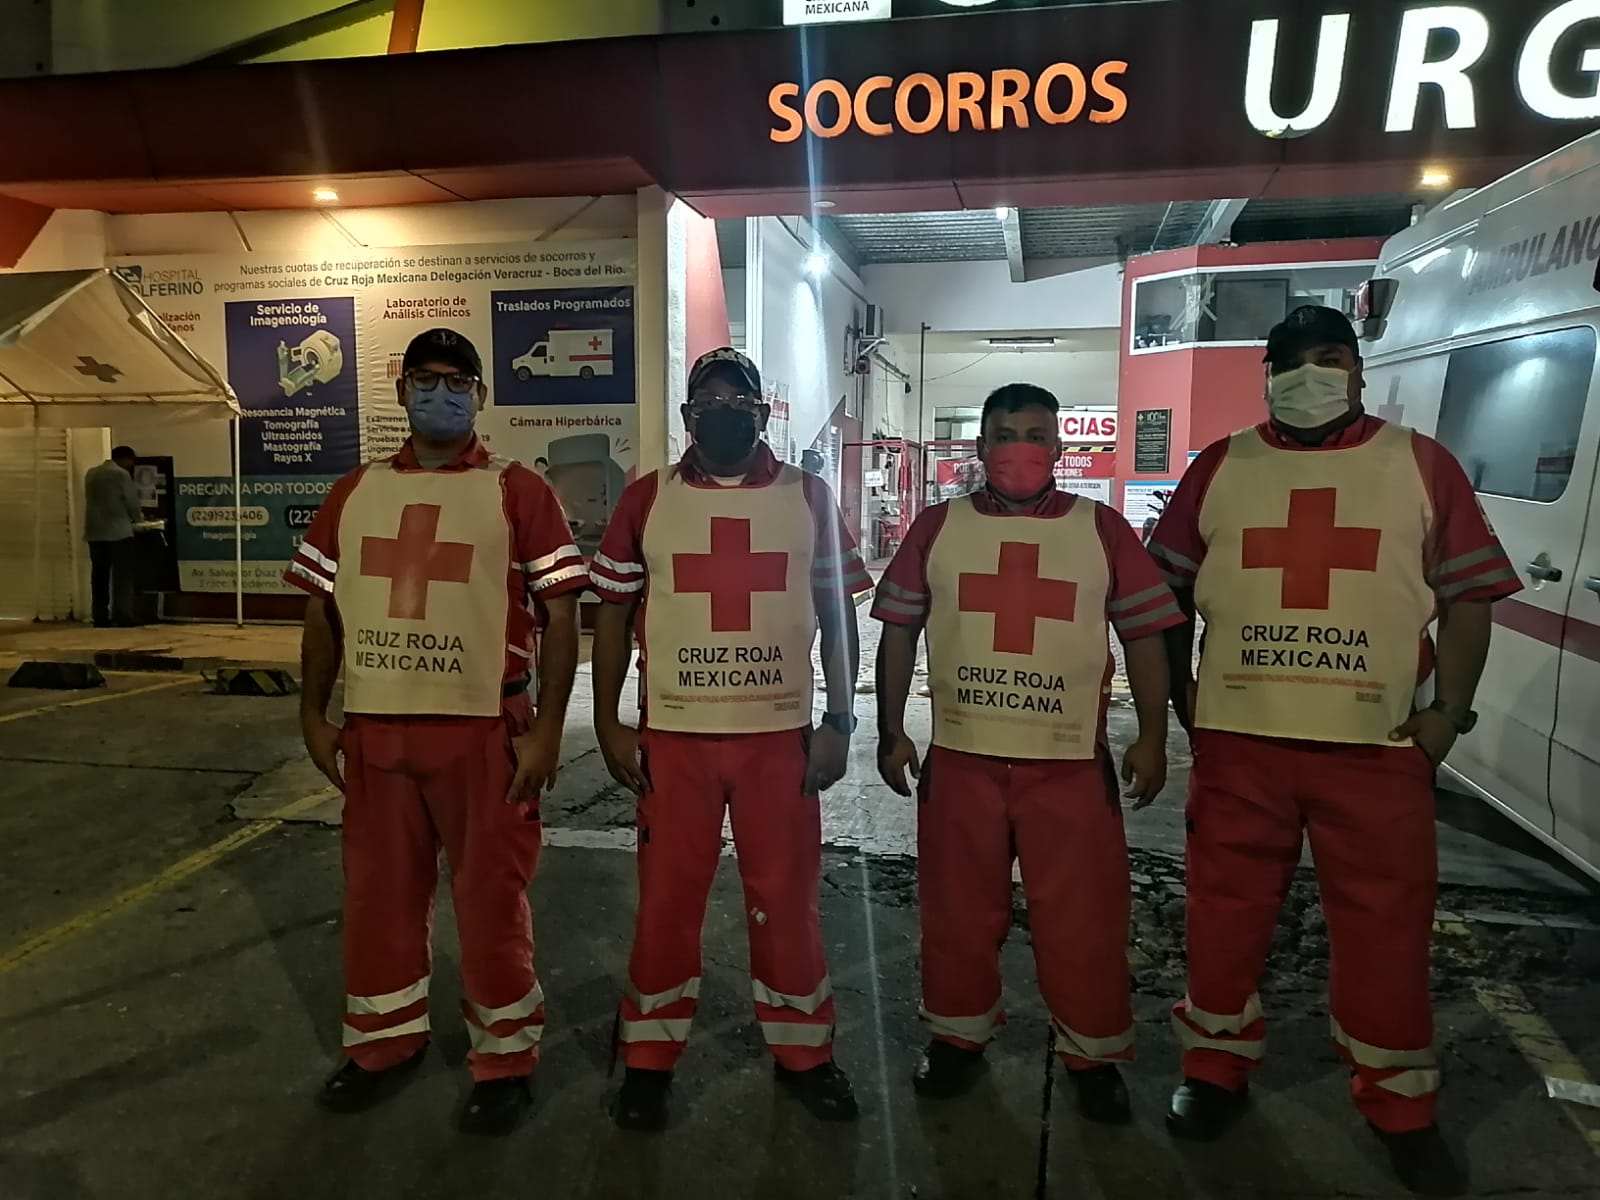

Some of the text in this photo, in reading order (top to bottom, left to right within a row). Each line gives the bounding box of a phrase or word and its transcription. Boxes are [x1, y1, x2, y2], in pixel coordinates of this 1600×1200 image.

[805, 0, 869, 15] MEXICANA
[768, 60, 1128, 143] SOCORROS
[240, 252, 595, 275] Nuestras cuotas de recuperación se destinan a servicios de socorros y
[144, 268, 202, 282] HOSPITAL
[214, 280, 265, 292] programas
[268, 277, 307, 288] sociales
[309, 276, 322, 287] de
[324, 276, 348, 286] Cruz
[351, 274, 374, 287] Roja
[377, 272, 427, 283] Mexicana
[430, 269, 491, 282] Delegación
[493, 269, 542, 279] Veracruz
[553, 267, 581, 277] Boca
[583, 265, 601, 276] del
[129, 282, 203, 297] OLFERINO
[256, 302, 319, 315] Servicio de
[386, 296, 467, 308] Laboratorio de
[496, 297, 631, 312] Traslados Programados
[383, 307, 471, 319] Análisis Clínicos
[250, 313, 327, 328] Imagenología
[240, 406, 346, 418] Resonancia Magnética
[263, 419, 319, 431] Tomografía
[509, 415, 622, 428] Cámara Hiperbárica
[261, 430, 323, 441] Ultrasonidos
[263, 441, 322, 453] Mastografía
[368, 446, 399, 454] Urgenci
[273, 453, 313, 464] Rayos X
[1064, 456, 1093, 467] TODOS
[1053, 468, 1083, 477] CACIONES
[178, 482, 251, 496] PREGUNA
[254, 482, 283, 495] POR
[192, 510, 263, 522] (229)923406
[208, 568, 252, 577] Salvaor
[357, 628, 464, 652] CRUZ ROJA
[1241, 625, 1369, 648] CRUZ ROJA
[678, 646, 783, 664] CRUZ ROJA
[1241, 649, 1367, 672] MEXICANA
[355, 651, 463, 674] MEXICANA
[678, 669, 783, 687] MEXICANA
[958, 665, 1065, 692] CRUZ ROJA
[957, 688, 1063, 714] MEXICANA
